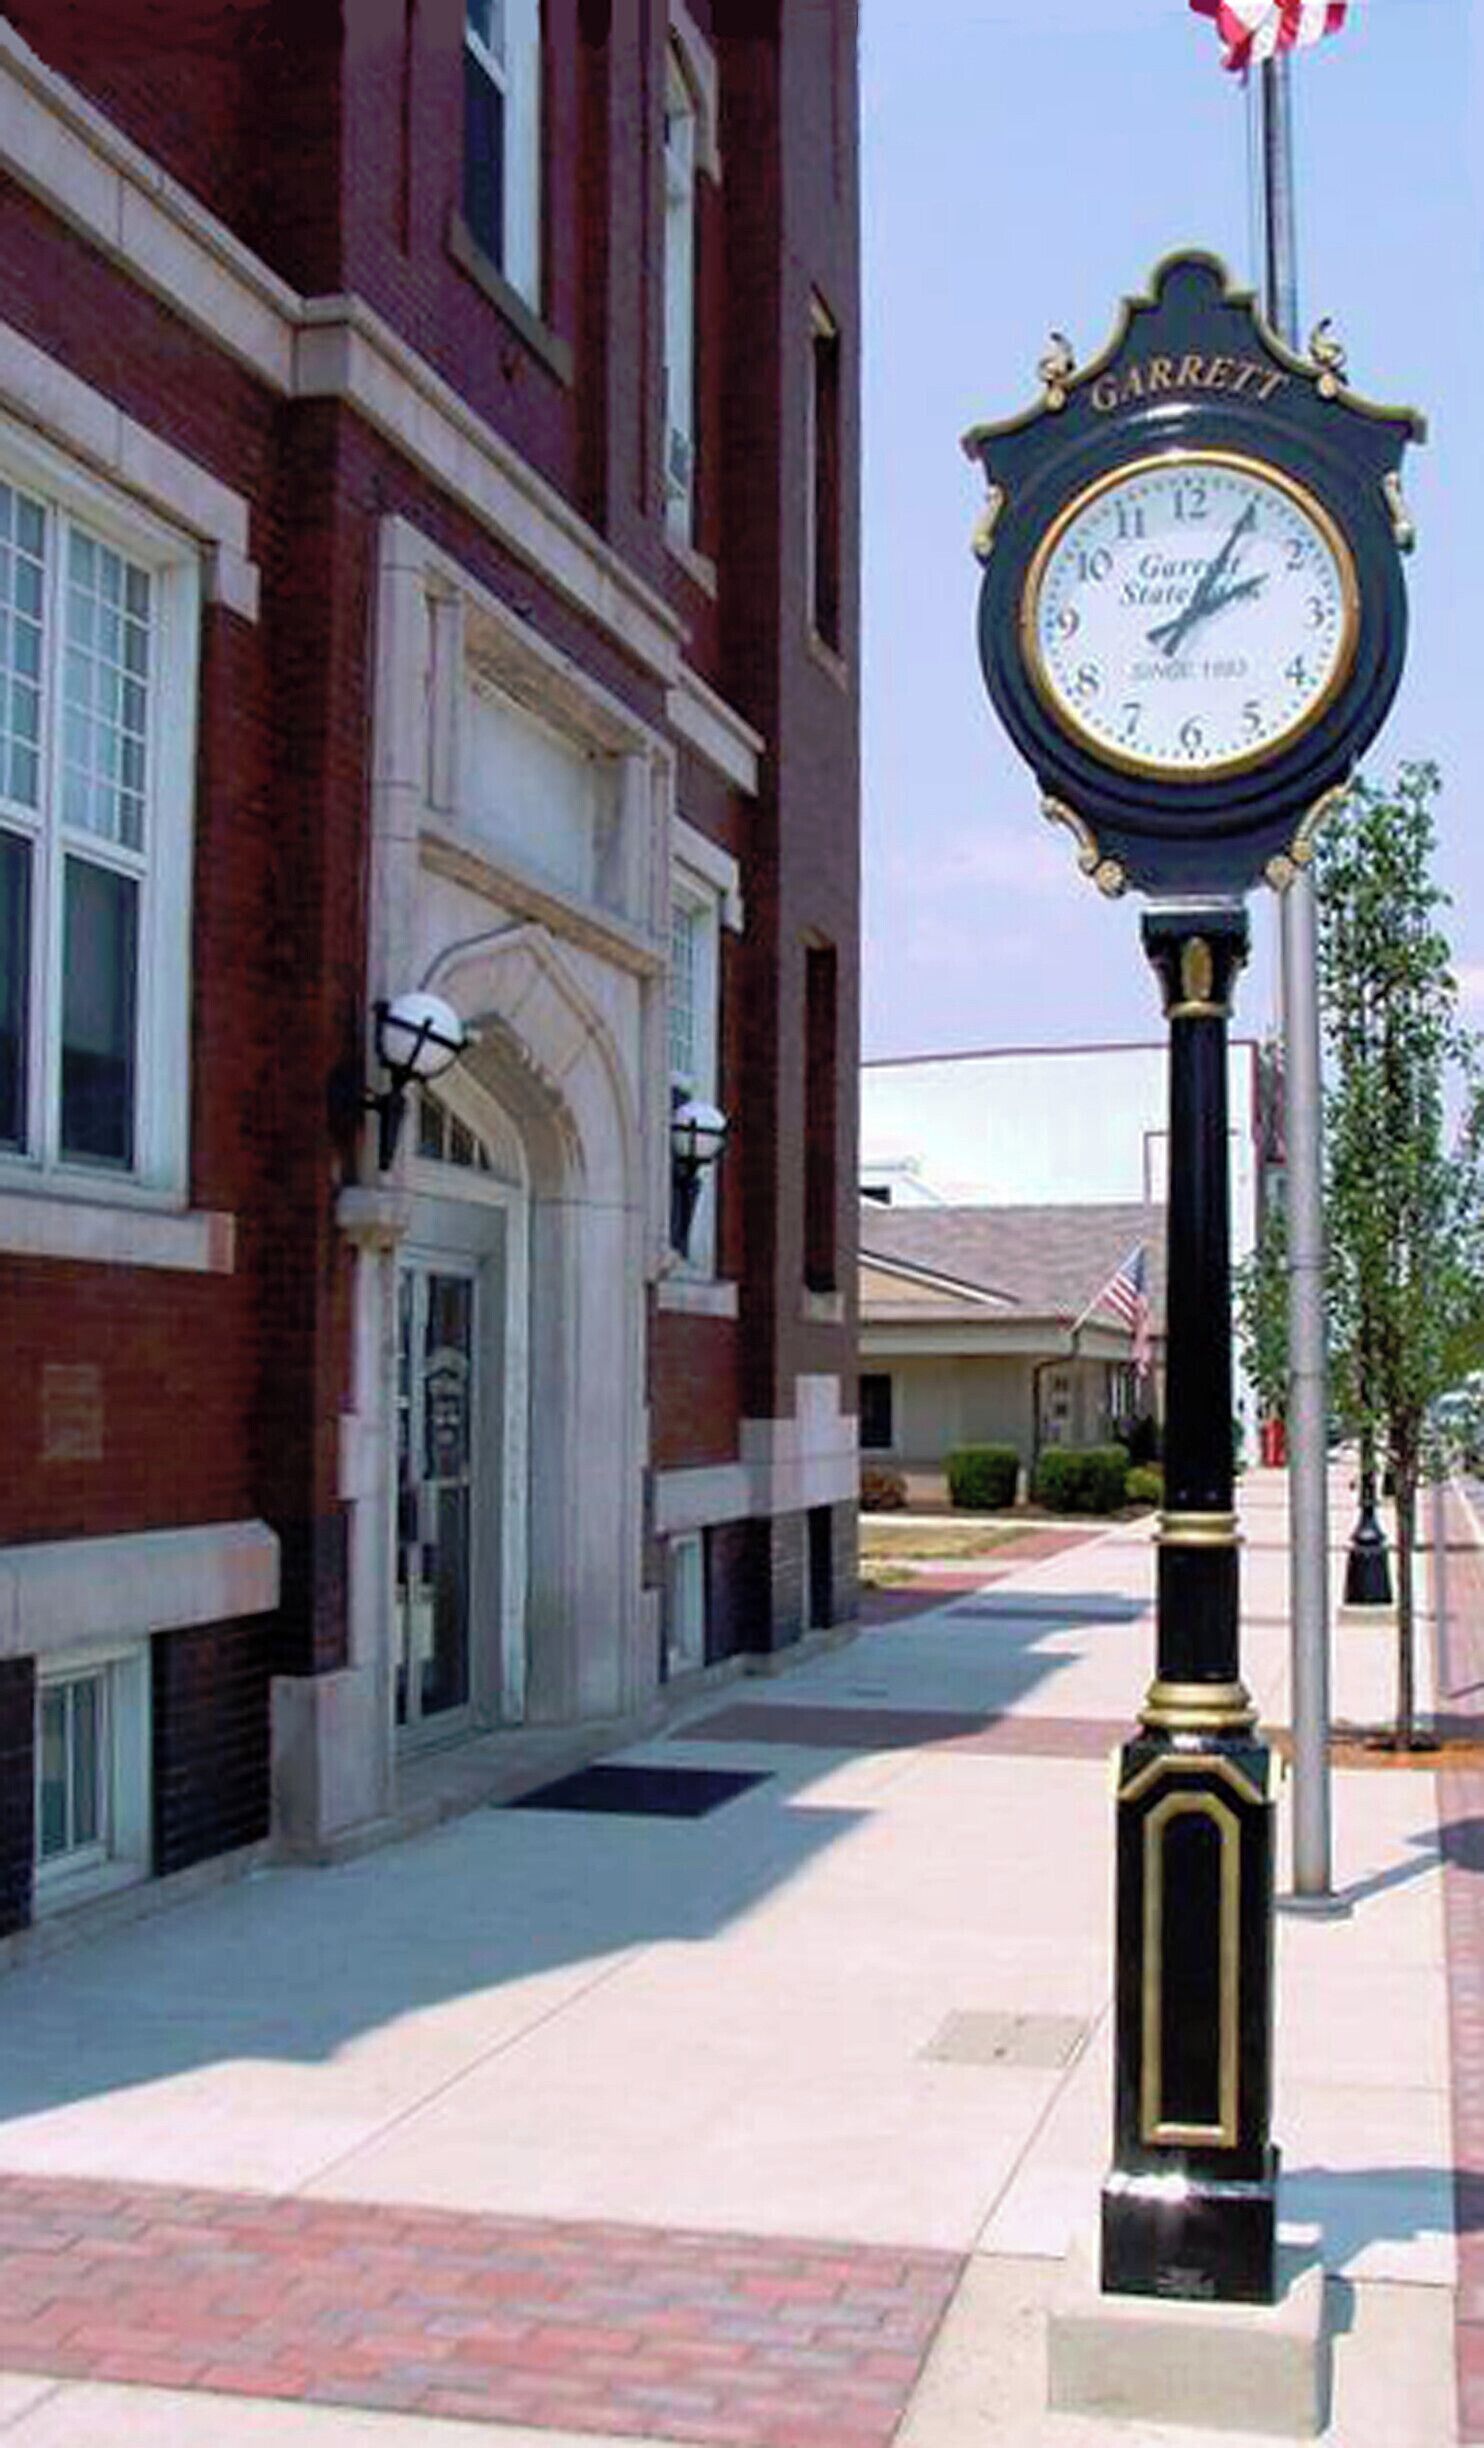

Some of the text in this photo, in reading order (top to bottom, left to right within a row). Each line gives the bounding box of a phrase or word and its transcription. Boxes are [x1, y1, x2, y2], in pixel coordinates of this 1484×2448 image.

[1092, 354, 1289, 411] GARRETT
[1115, 500, 1145, 539] 11
[1174, 488, 1207, 521] 12
[1078, 548, 1113, 582] 10
[1138, 554, 1240, 580] Garrt
[1284, 538, 1305, 571] 2
[1119, 582, 1188, 605] State
[1057, 607, 1079, 639] 9
[1307, 596, 1325, 629] 3
[1076, 664, 1100, 696] 8
[1131, 660, 1199, 681] SINCE
[1285, 655, 1306, 686] 4
[1122, 702, 1141, 735] 7
[1180, 715, 1203, 748] 6
[1243, 701, 1262, 731] 5
